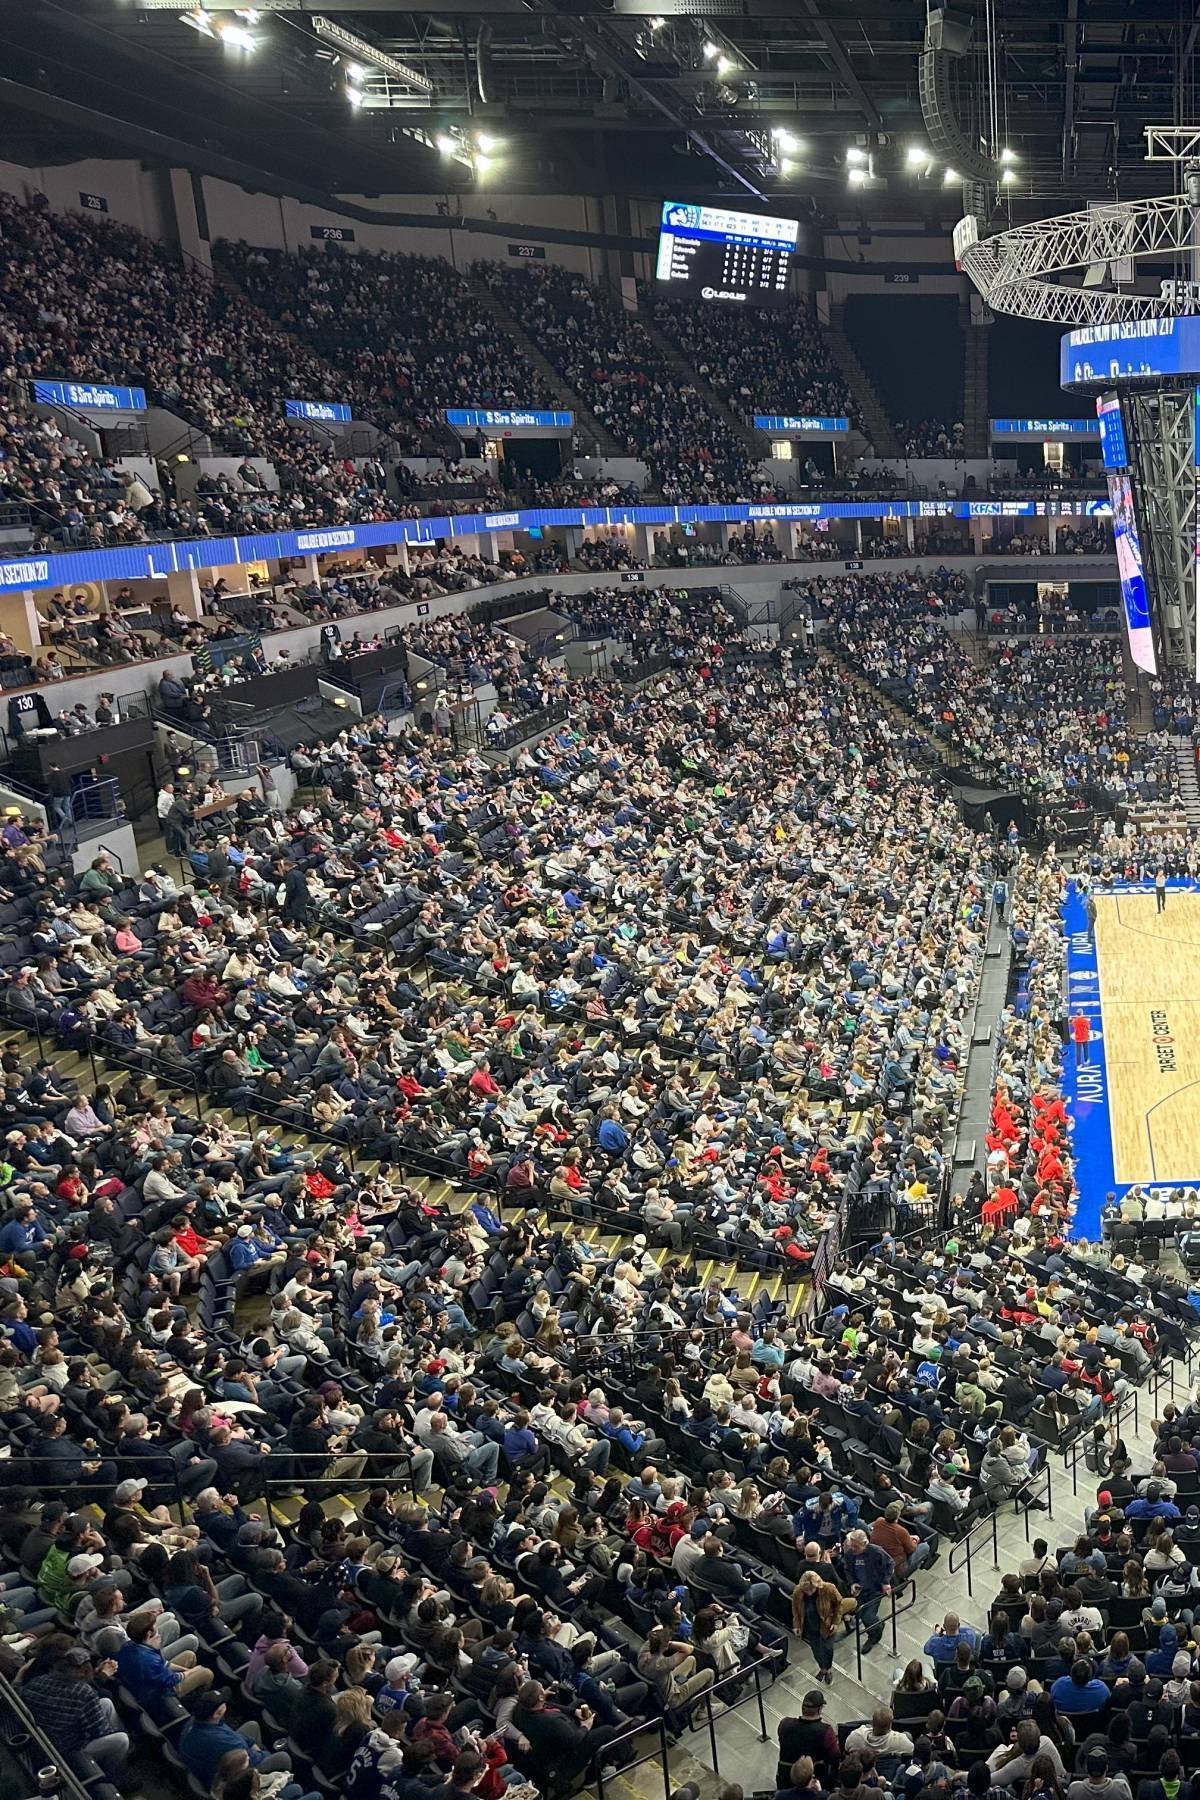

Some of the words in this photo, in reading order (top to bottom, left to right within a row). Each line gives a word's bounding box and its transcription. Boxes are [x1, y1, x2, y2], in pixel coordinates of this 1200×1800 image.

[323, 229, 343, 240] 236
[518, 246, 535, 257] 237
[713, 290, 747, 301] LEXUS
[78, 386, 92, 403] Sire
[92, 387, 115, 407] Spirits
[494, 412, 510, 424] Sire
[510, 412, 535, 425] Spirits
[1034, 420, 1047, 430] Sire
[1048, 420, 1069, 432] Spirits
[971, 503, 999, 513] KFAN
[3, 562, 38, 585] SECTION
[17, 695, 34, 711] 130
[1150, 1010, 1170, 1035] CENTER
[1156, 1044, 1177, 1073] TARGET
